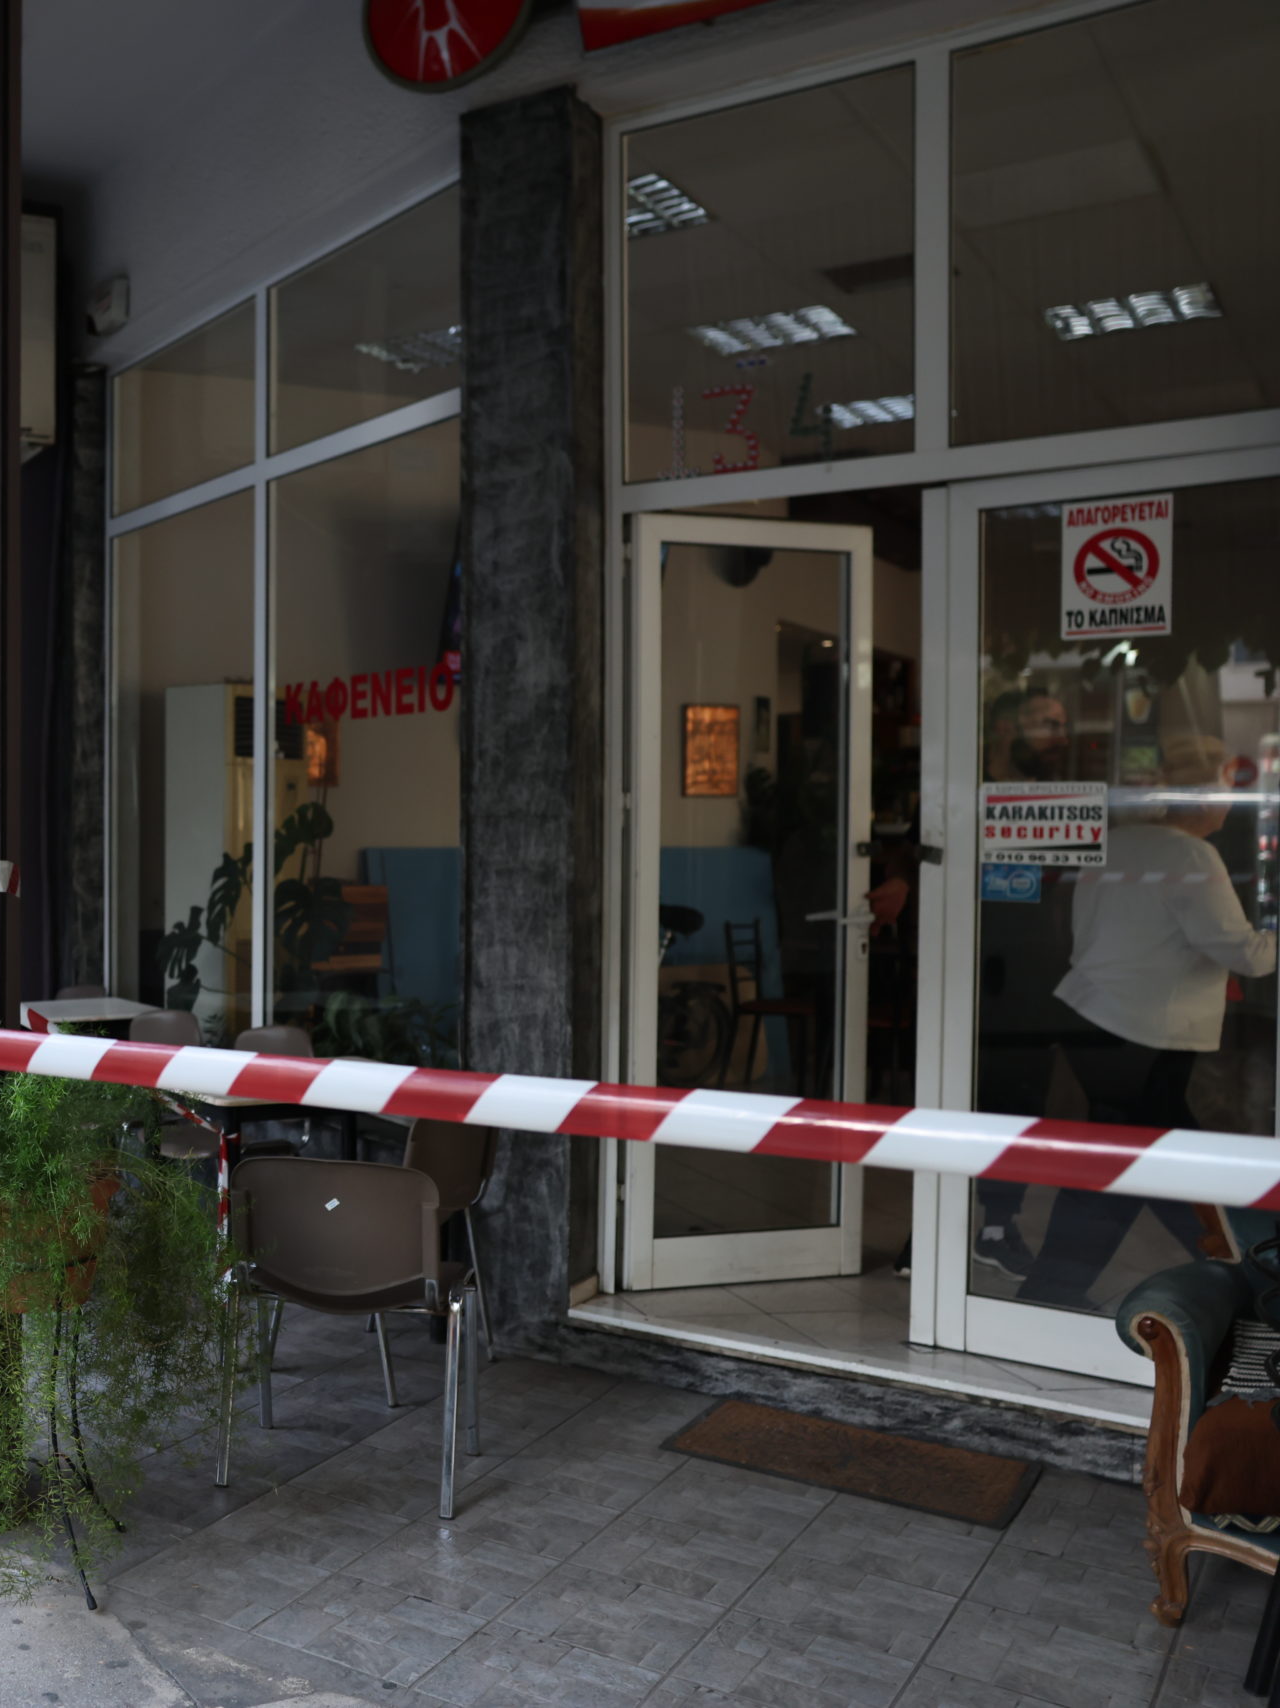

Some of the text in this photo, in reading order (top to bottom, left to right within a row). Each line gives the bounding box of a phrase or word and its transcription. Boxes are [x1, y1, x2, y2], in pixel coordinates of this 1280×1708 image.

[1066, 500, 1169, 528] ΑΠΑΓΟΡΕΥΕΤΑΙ
[1066, 604, 1166, 629] ΤΟ ΚΑΠΝΙΣΜΑ
[284, 662, 454, 726] ΚΑΦΕΝΕΙΟ
[985, 805, 1103, 821] KARAKITSOS
[984, 824, 1102, 843] security
[996, 853, 1103, 863] 010 96 33 100
